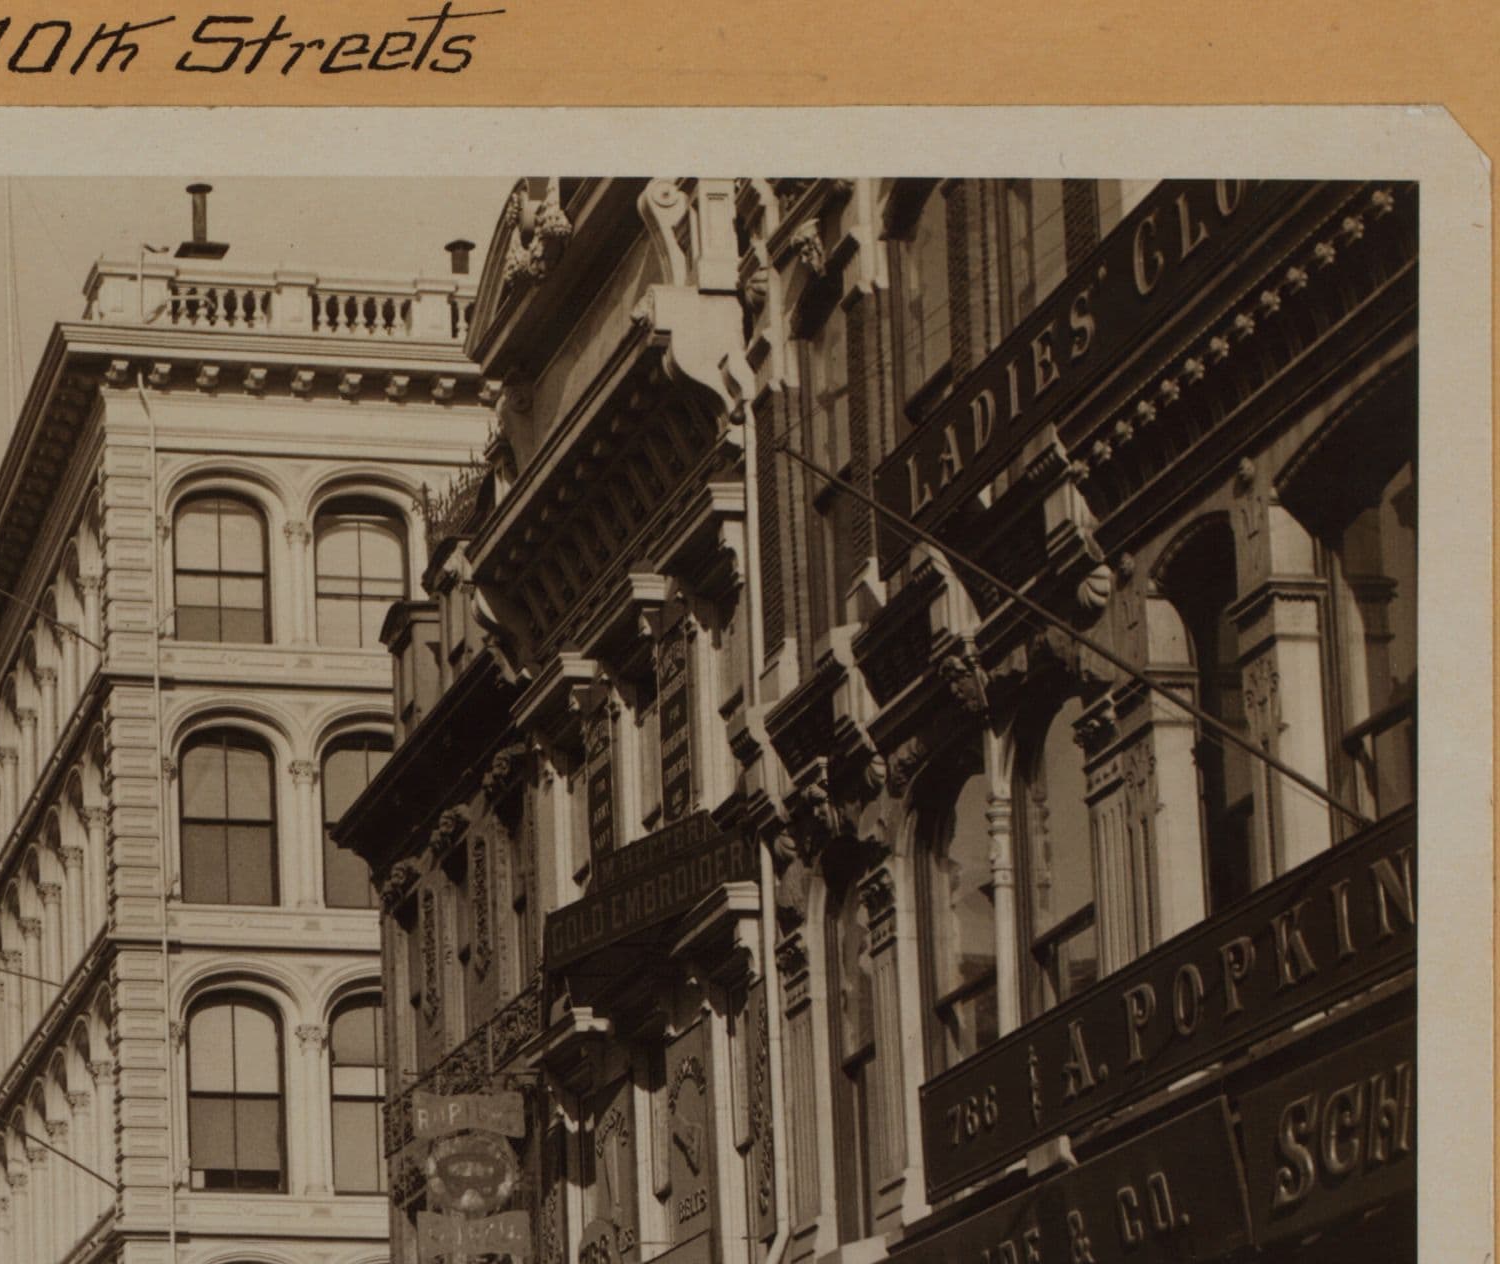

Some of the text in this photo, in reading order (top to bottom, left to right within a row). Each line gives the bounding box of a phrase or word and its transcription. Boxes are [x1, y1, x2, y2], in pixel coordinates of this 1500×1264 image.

[175, 2, 506, 73] Streets
[550, 831, 761, 955] GOLD EMBROIDERY
[946, 1084, 999, 1145] 766
[1115, 1170, 1191, 1244] CO.
